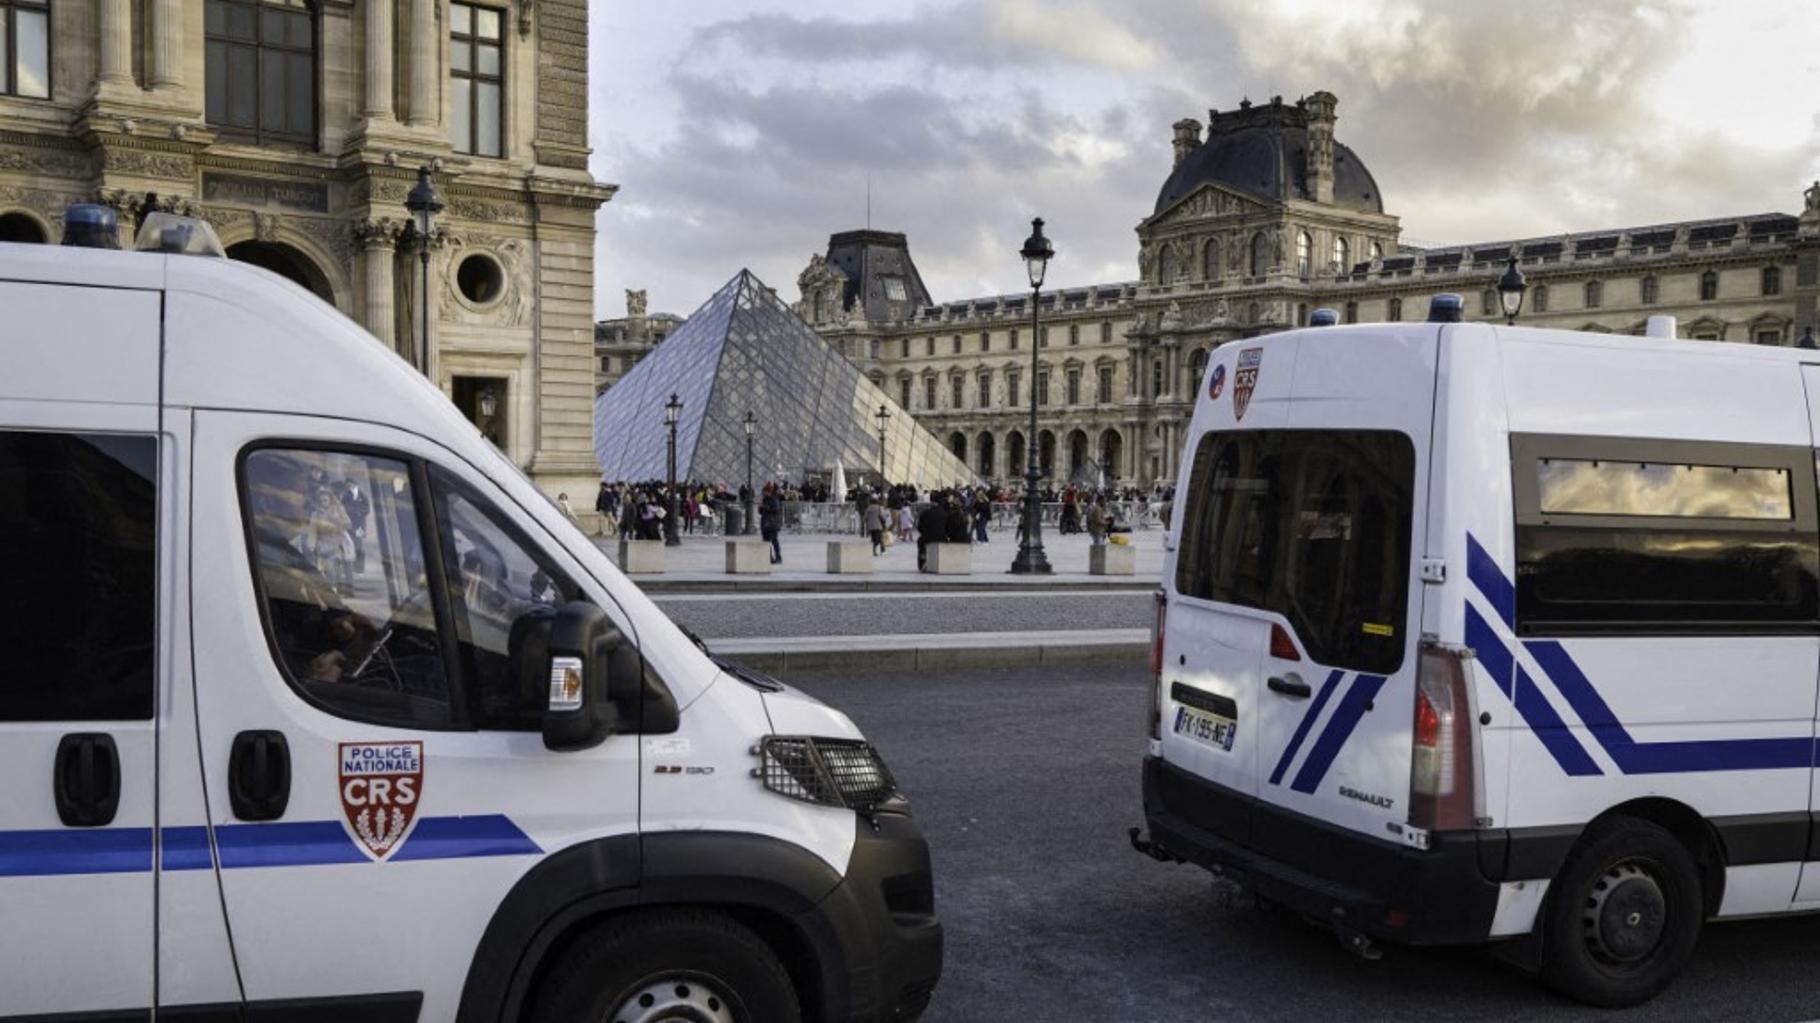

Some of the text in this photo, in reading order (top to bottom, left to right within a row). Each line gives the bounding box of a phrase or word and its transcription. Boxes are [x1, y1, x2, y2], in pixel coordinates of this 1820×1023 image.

[1236, 370, 1256, 388] CRS
[352, 747, 412, 760] POLICE
[344, 759, 418, 773] NATIONALE
[344, 777, 416, 806] CRS
[1339, 786, 1394, 808] RENAULT
